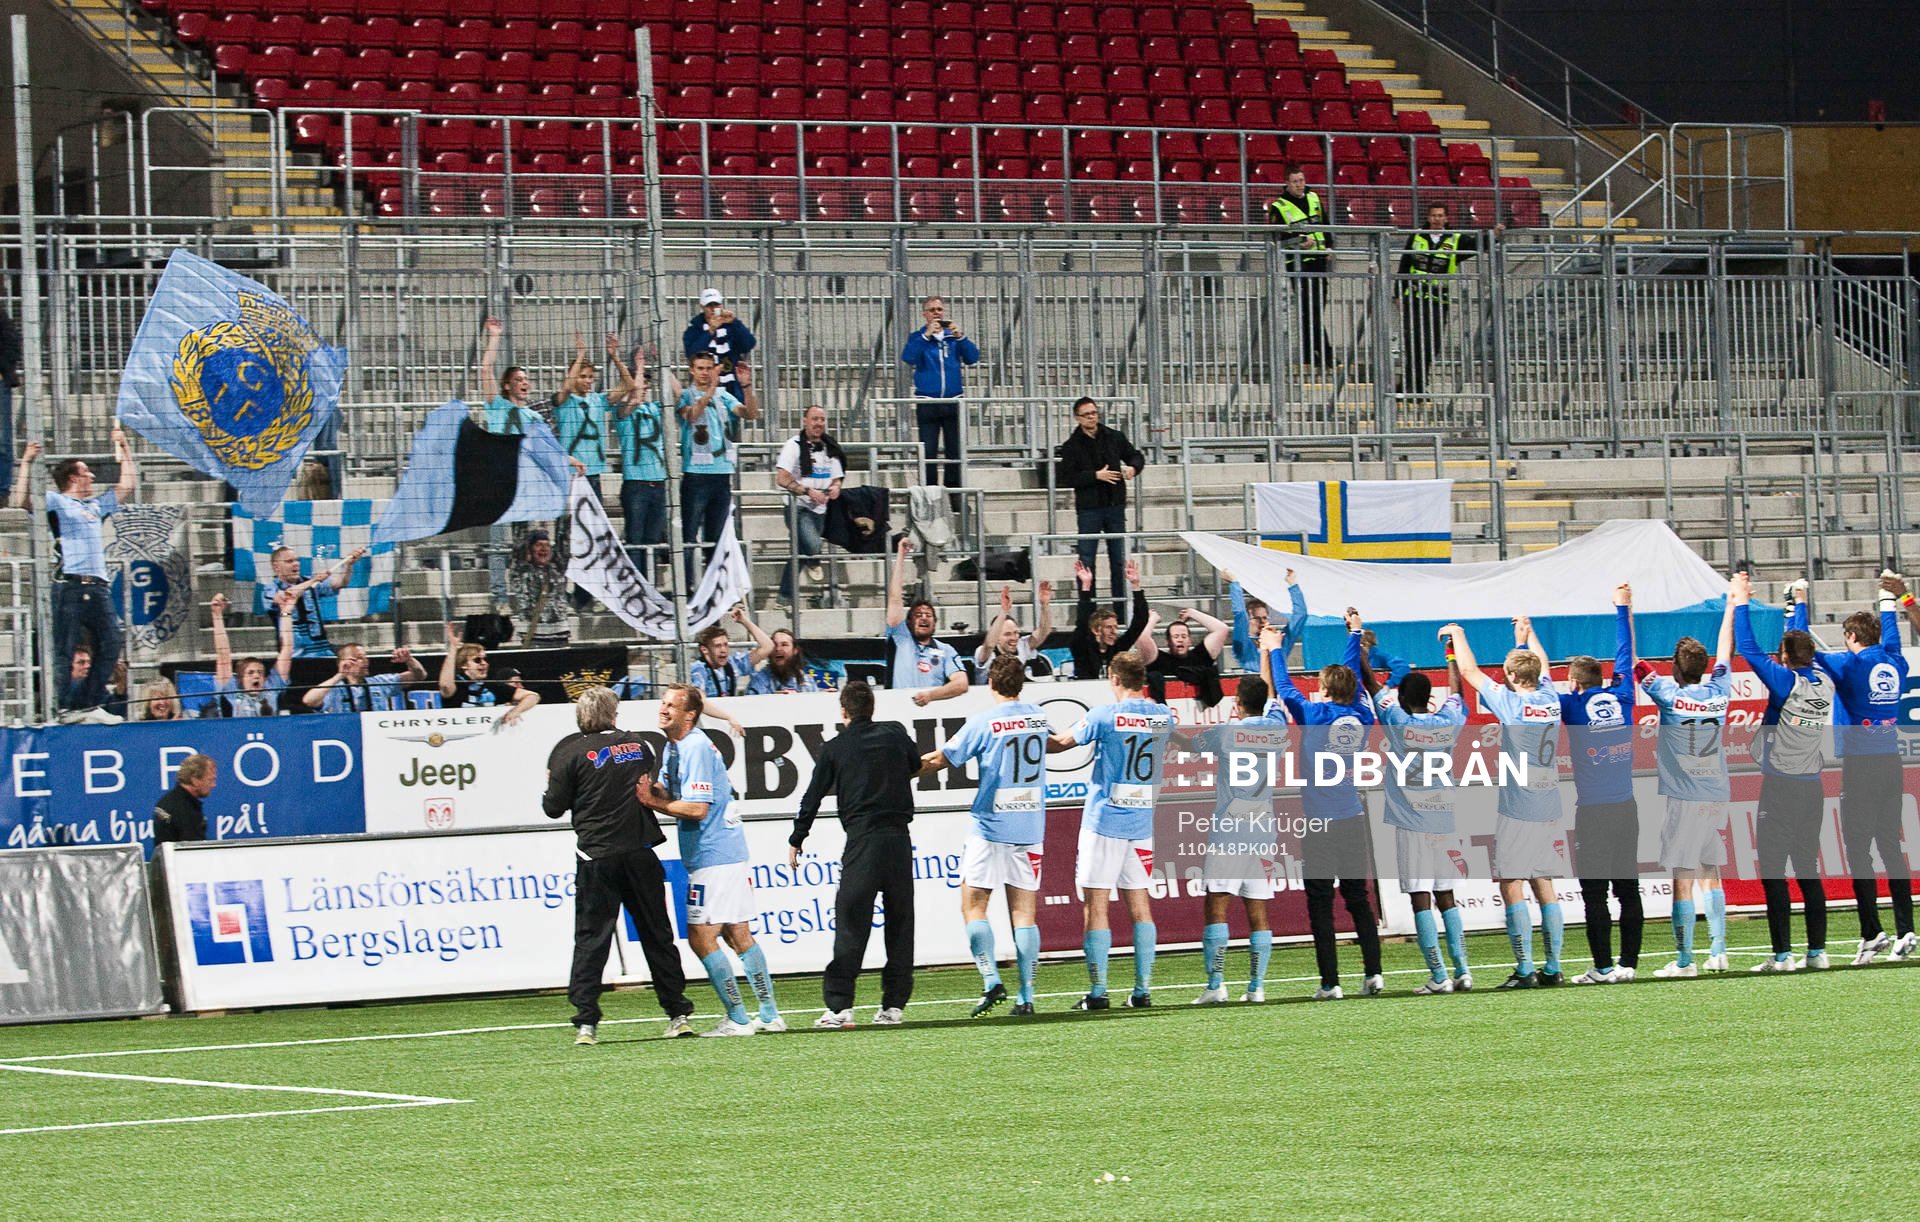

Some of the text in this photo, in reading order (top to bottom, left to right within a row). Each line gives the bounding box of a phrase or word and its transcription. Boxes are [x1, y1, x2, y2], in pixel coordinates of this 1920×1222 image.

[379, 716, 493, 729] CHRYSLER
[1681, 717, 1720, 757] 12
[609, 742, 642, 756] INTER
[1005, 734, 1043, 784] 19
[1124, 734, 1159, 782] 16
[1538, 723, 1555, 767] 6
[399, 757, 477, 790] Jeep
[217, 802, 269, 841] på!
[282, 866, 576, 913] Länsförsäkringa
[288, 920, 503, 967] Bergslagen
